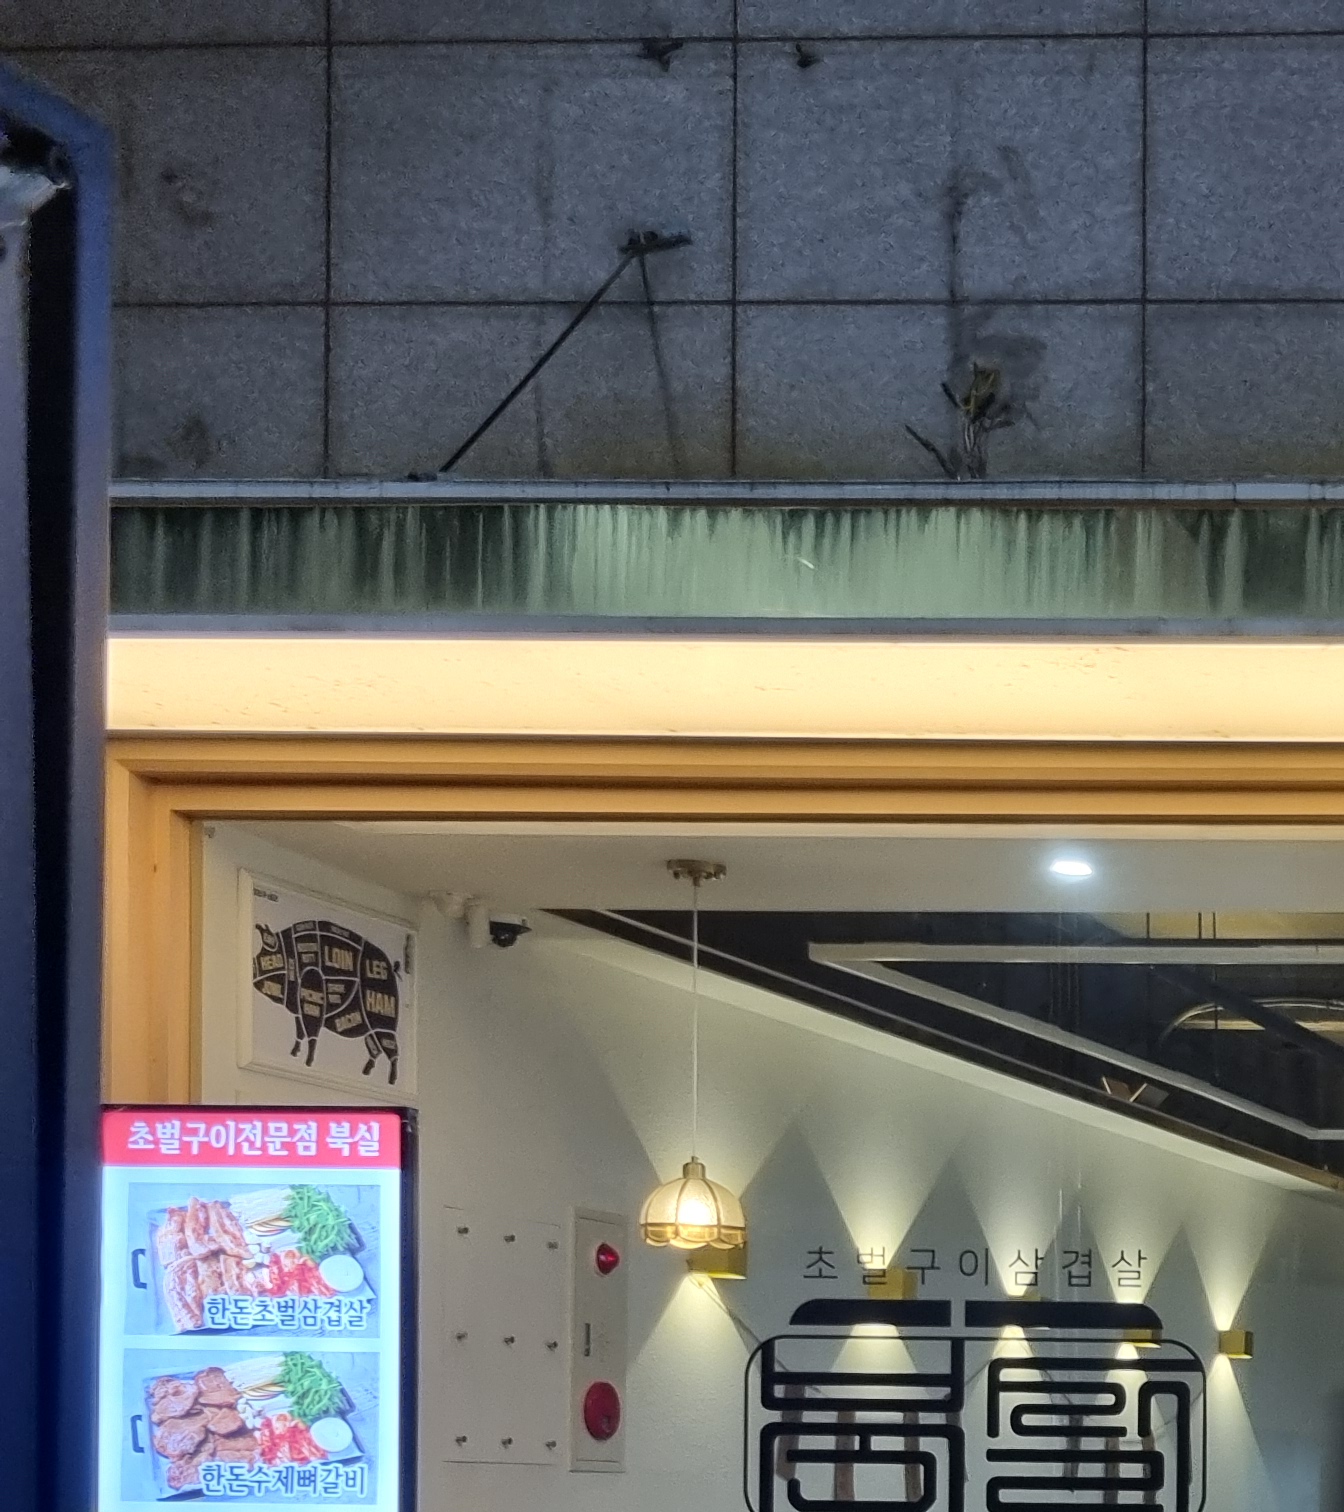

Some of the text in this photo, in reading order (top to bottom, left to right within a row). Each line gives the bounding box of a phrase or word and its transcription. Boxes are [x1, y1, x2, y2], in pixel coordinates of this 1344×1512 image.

[127, 1120, 381, 1157] 초벌구이전문점 북실
[802, 1245, 1150, 1290] 초벌구이삼겹살
[206, 1297, 369, 1329] 한돈초벌삼겹살
[200, 1465, 366, 1496] 한돈수제뼈갈비
